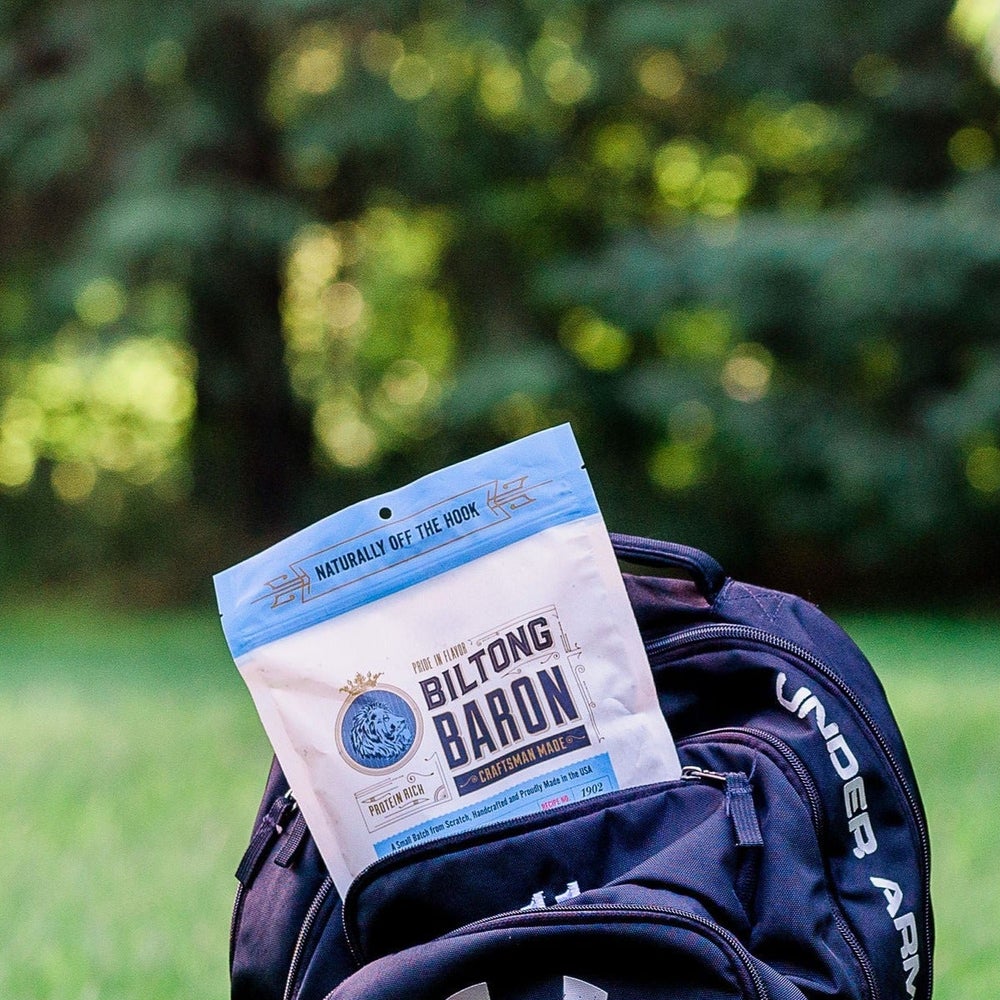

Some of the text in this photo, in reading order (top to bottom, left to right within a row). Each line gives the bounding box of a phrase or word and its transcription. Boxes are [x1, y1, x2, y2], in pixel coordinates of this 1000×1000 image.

[315, 502, 480, 581] NATURALLY OFF THE HOOK
[412, 641, 467, 674] PRIDE IN FLAVOR
[419, 616, 553, 711] BILTONG
[433, 665, 580, 770] BARON
[478, 736, 567, 783] CRAFTSMAN MADE
[581, 782, 604, 798] 1902
[776, 672, 878, 860] UNDER
[368, 784, 426, 817] PROTEIN RICH
[397, 835, 412, 849] Small
[412, 828, 431, 842] Batch
[430, 823, 445, 836] from
[445, 814, 473, 829] Scratch,
[472, 797, 509, 819] Handcrafted
[508, 792, 520, 803] and
[520, 781, 543, 799] Proudly
[543, 777, 561, 790] Made
[561, 773, 569, 782] in
[568, 770, 580, 781] the
[579, 764, 594, 777] USA
[541, 798, 561, 810] RECIPE
